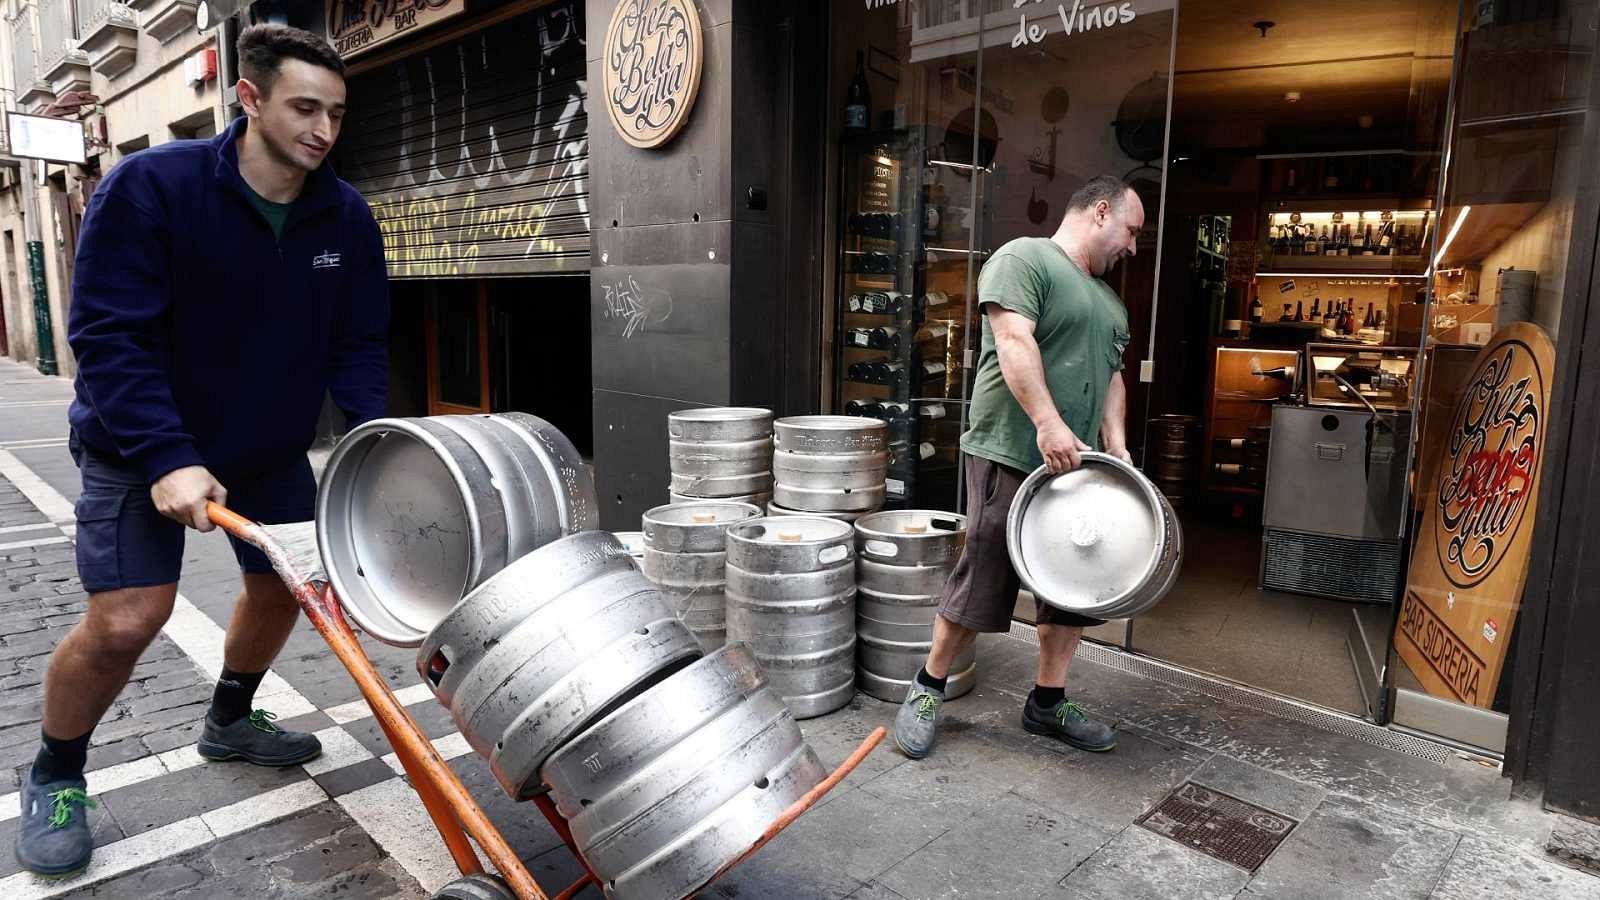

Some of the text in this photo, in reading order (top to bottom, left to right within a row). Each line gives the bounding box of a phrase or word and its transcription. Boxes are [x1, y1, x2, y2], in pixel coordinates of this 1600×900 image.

[394, 8, 418, 30] BAR
[1011, 0, 1136, 49] de Vinos
[1402, 595, 1481, 707] BAR SIDRERIA
